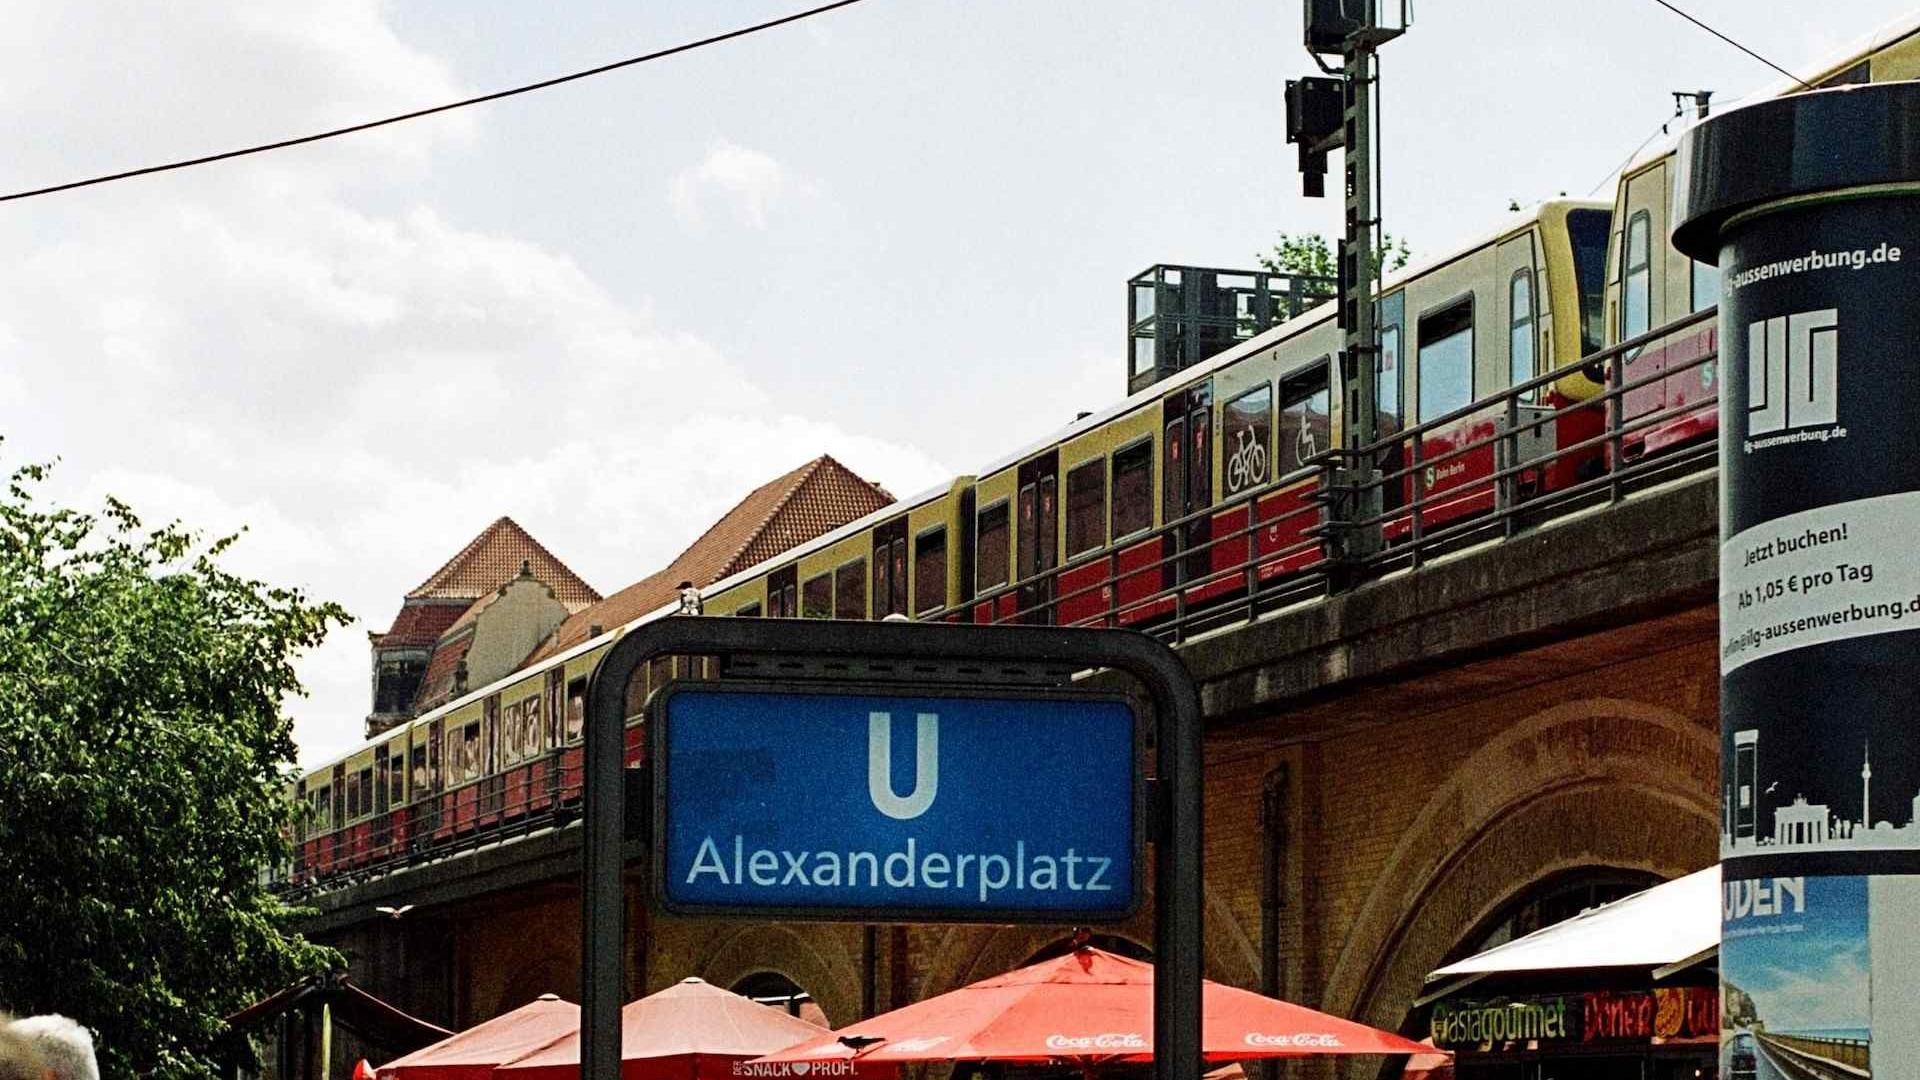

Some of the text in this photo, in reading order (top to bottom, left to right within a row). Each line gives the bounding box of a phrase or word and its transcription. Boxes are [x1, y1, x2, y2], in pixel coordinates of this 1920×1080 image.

[1744, 522, 1848, 567] Jetzt buchen!
[1738, 564, 1873, 610] Ab 1,05 € pro Tag
[868, 711, 939, 820] U
[685, 835, 1113, 902] Alexanderplatz
[1046, 1033, 1150, 1049] Coca-Cola
[1244, 1031, 1345, 1048] Coca-Cola
[1449, 996, 1567, 1052] asiagourmet
[743, 1061, 792, 1077] SNACK
